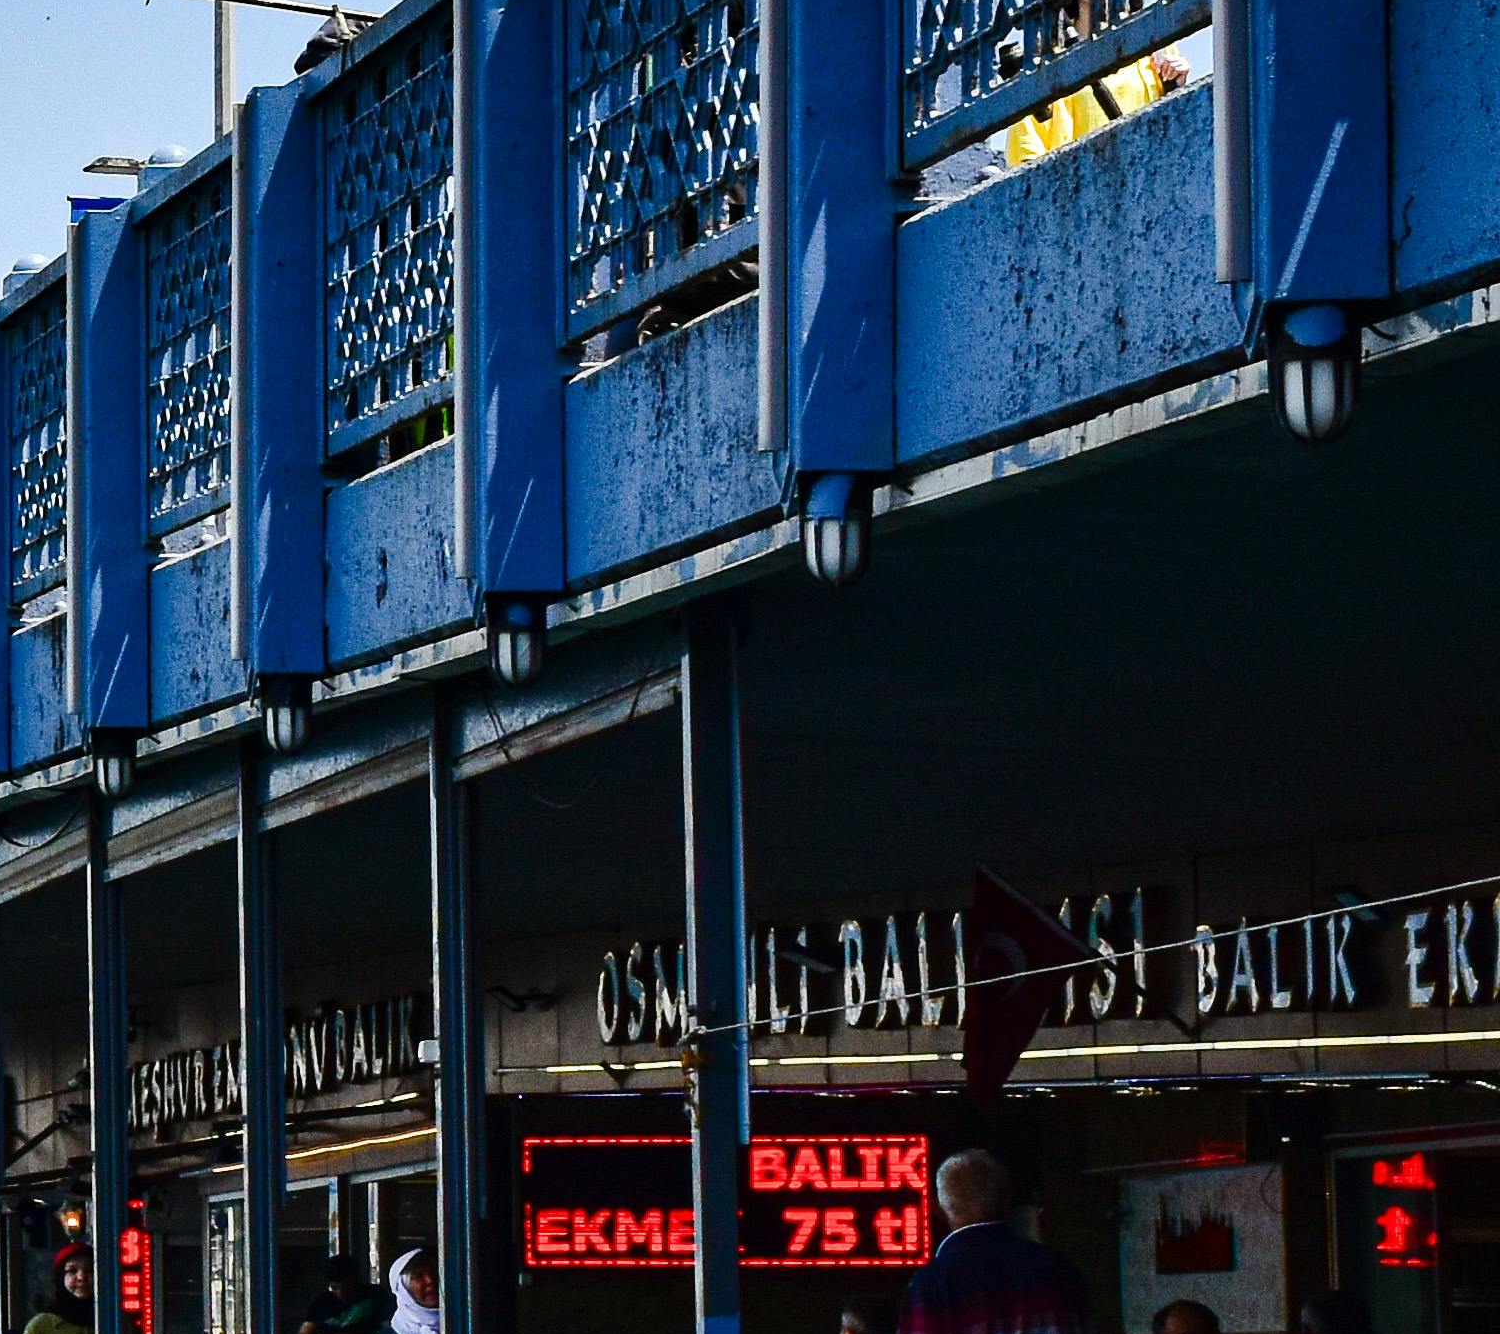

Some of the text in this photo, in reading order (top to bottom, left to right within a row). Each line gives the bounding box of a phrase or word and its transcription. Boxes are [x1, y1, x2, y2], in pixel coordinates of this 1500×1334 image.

[1403, 897, 1500, 1008] EK
[750, 1146, 927, 1190] BALIK
[536, 1208, 744, 1253] EKME
[782, 1209, 858, 1254] 75
